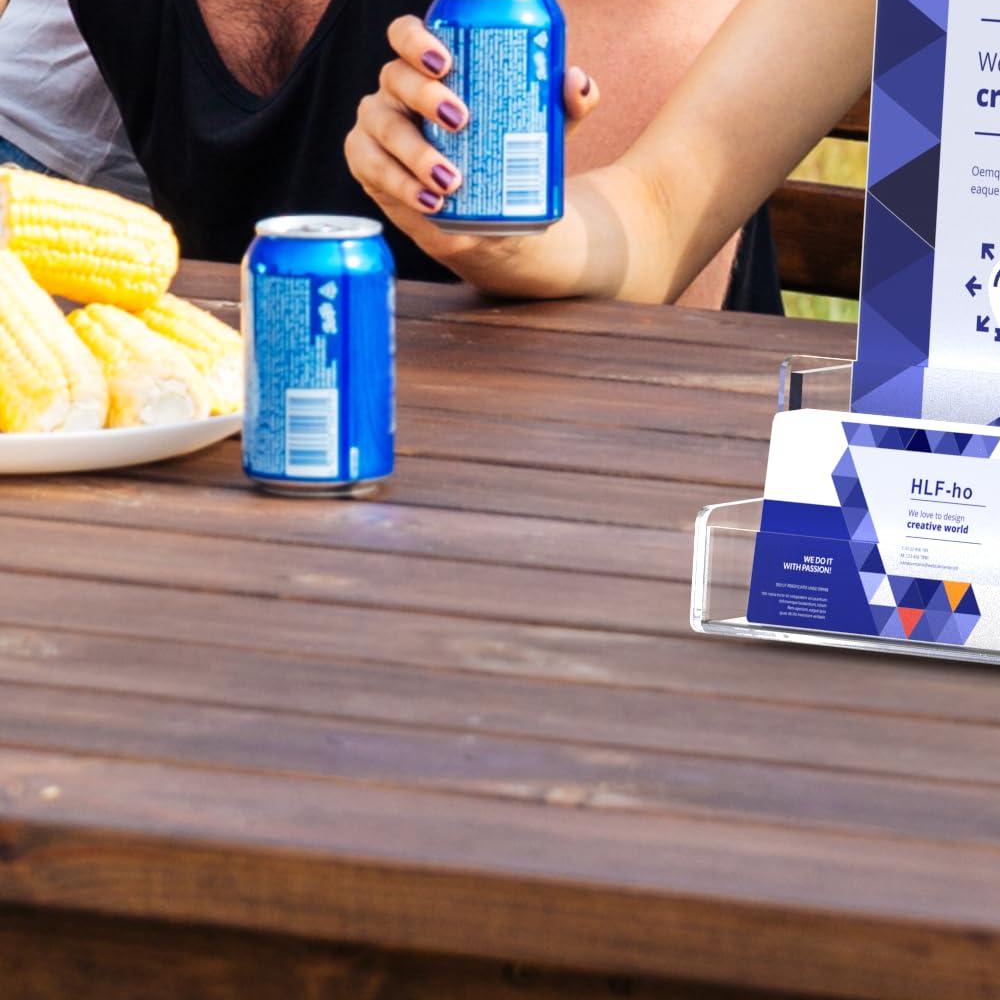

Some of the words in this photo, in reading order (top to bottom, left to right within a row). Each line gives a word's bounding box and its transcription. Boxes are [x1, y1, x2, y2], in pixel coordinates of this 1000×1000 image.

[970, 185, 1000, 198] eaque
[910, 478, 973, 500] HLF-ho
[908, 508, 918, 518] We
[919, 510, 933, 520] love
[943, 512, 965, 523] design
[906, 520, 941, 532] creative
[944, 523, 969, 534] world
[804, 555, 815, 564] WE
[784, 562, 801, 571] WITH
[802, 564, 832, 574] PASSION!
